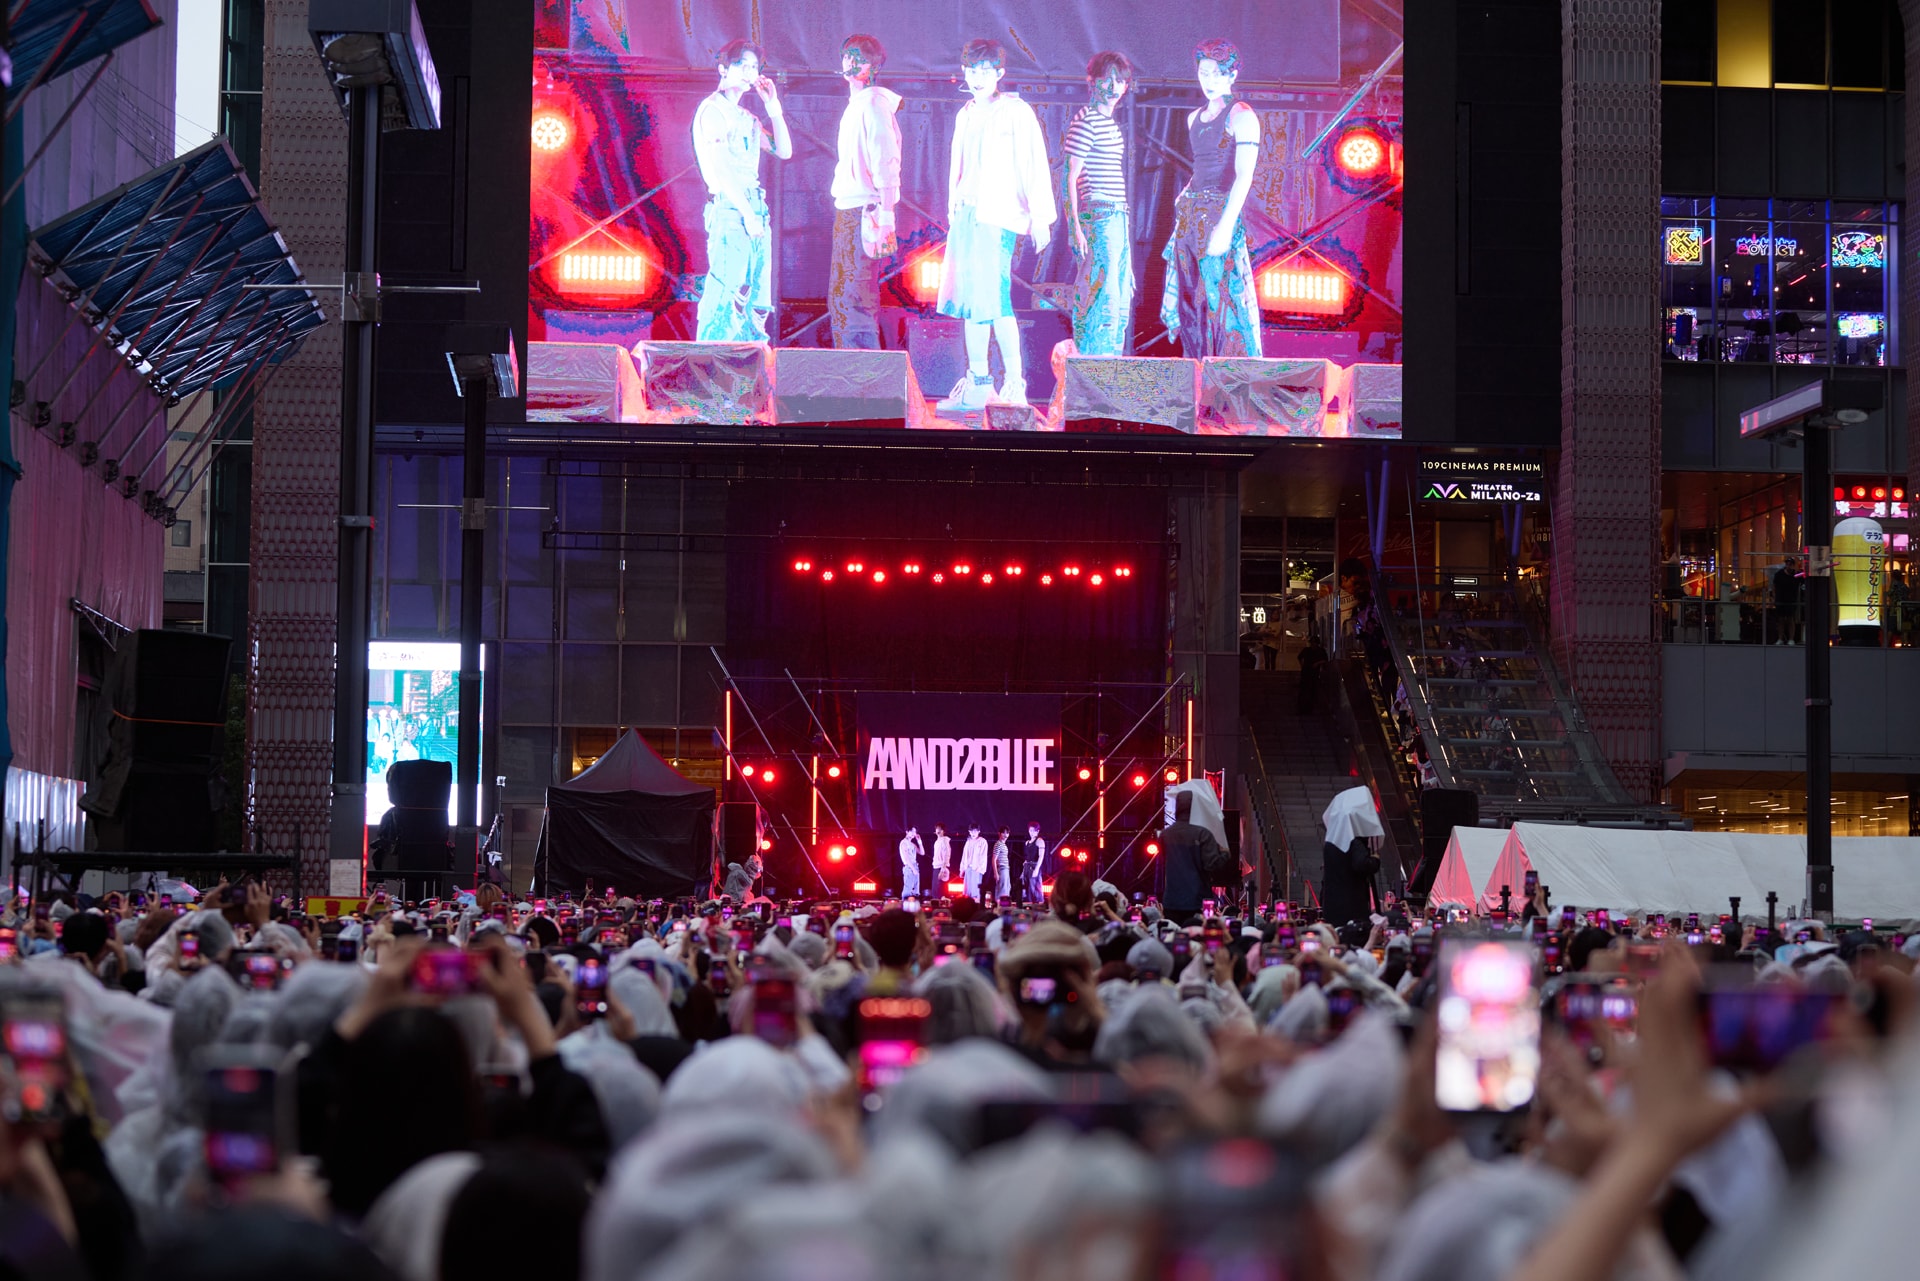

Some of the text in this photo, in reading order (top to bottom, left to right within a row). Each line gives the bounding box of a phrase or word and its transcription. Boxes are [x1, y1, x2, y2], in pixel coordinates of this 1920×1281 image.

[1422, 461, 1541, 472] 109CINEMAS PREMIUM
[1471, 483, 1513, 491] THEATER
[1470, 490, 1541, 501] MILANO-Za
